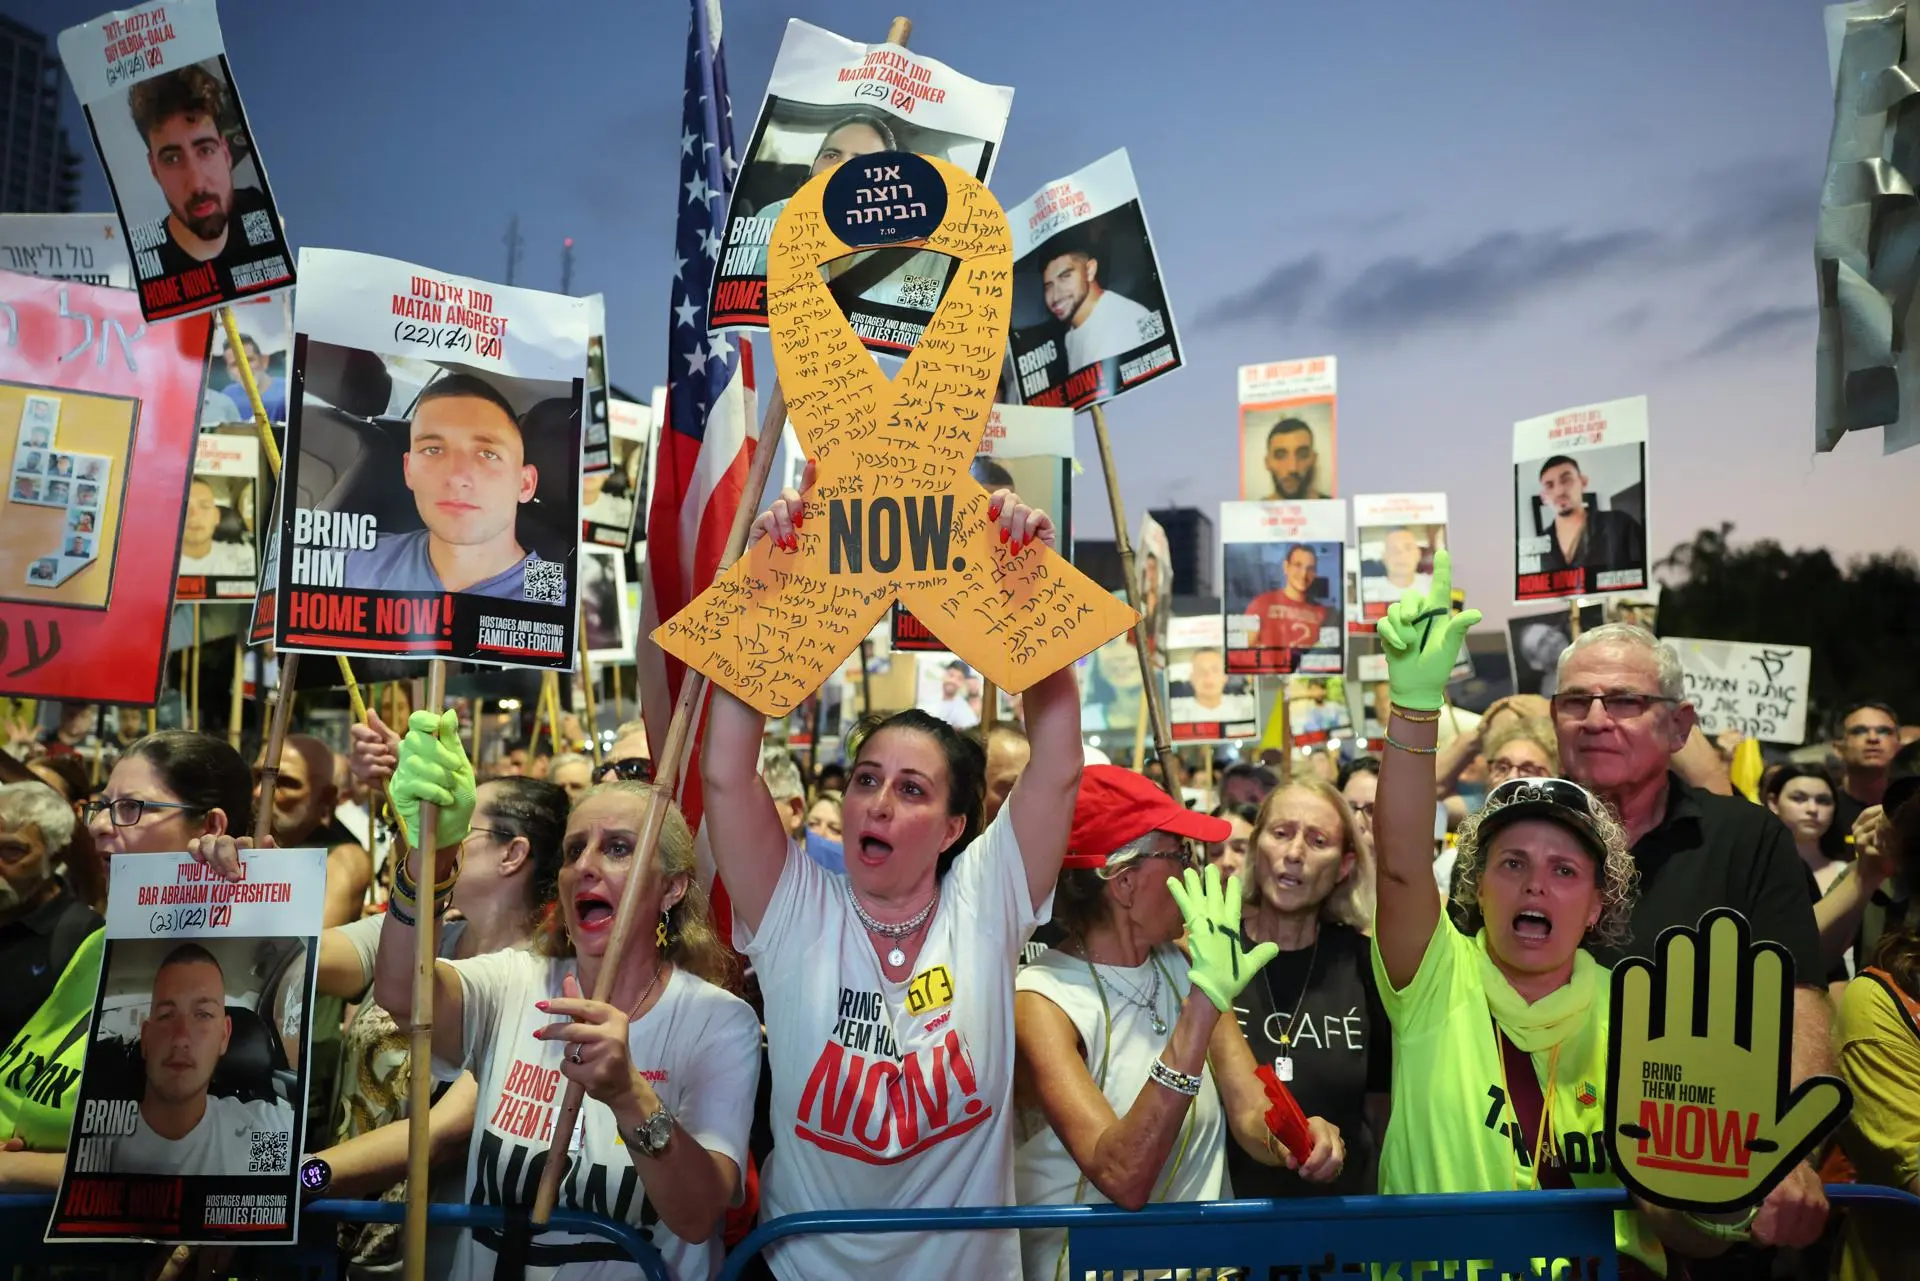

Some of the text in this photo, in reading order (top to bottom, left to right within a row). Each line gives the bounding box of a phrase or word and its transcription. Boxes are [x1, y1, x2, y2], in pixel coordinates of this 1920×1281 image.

[838, 66, 946, 104] MATAN ZANGAUKER
[910, 64, 932, 84] מתן
[864, 166, 900, 182] אני
[856, 184, 913, 204] רוצה
[846, 202, 927, 225] הביתה
[129, 217, 168, 251] BRING
[728, 216, 778, 246] BRIN
[880, 228, 896, 236] 7.10
[134, 249, 164, 280] HIM
[720, 247, 760, 276] HIM
[143, 276, 182, 309] HOME
[180, 260, 220, 300] NOW!
[714, 280, 767, 312] HOME
[392, 294, 509, 337] MATAN ANGREST
[468, 290, 493, 314] מתן
[850, 312, 924, 334] HOSTAGES AND MISSIN
[890, 328, 921, 348] FORU
[1018, 340, 1058, 376] BRING
[1022, 368, 1050, 398] HIM
[294, 508, 378, 550] BRING
[291, 549, 346, 588] HIM
[289, 591, 456, 636] HOME NOW!
[480, 615, 564, 636] HOSTAGES AND MISSING
[478, 628, 564, 653] FAMILIES FORUM
[138, 883, 292, 906] BAR ABRAHAM KUPERSHTEIN
[907, 966, 953, 1012] 673
[838, 988, 883, 1022] RING
[1264, 1007, 1363, 1050] CAFÉ
[504, 1058, 561, 1104] BRING
[1642, 1062, 1682, 1082] BRING
[797, 1029, 983, 1152] NOW!
[1642, 1080, 1716, 1104] THEM HOME
[81, 1100, 139, 1136] BRING
[490, 1093, 540, 1140] THEM
[1638, 1100, 1760, 1166] NOW
[74, 1137, 113, 1173] HIM
[64, 1178, 183, 1221] HOME NOW!
[206, 1194, 287, 1207] HOSTAGES AND MISSING
[204, 1207, 286, 1225] FAMILIES FORUM
